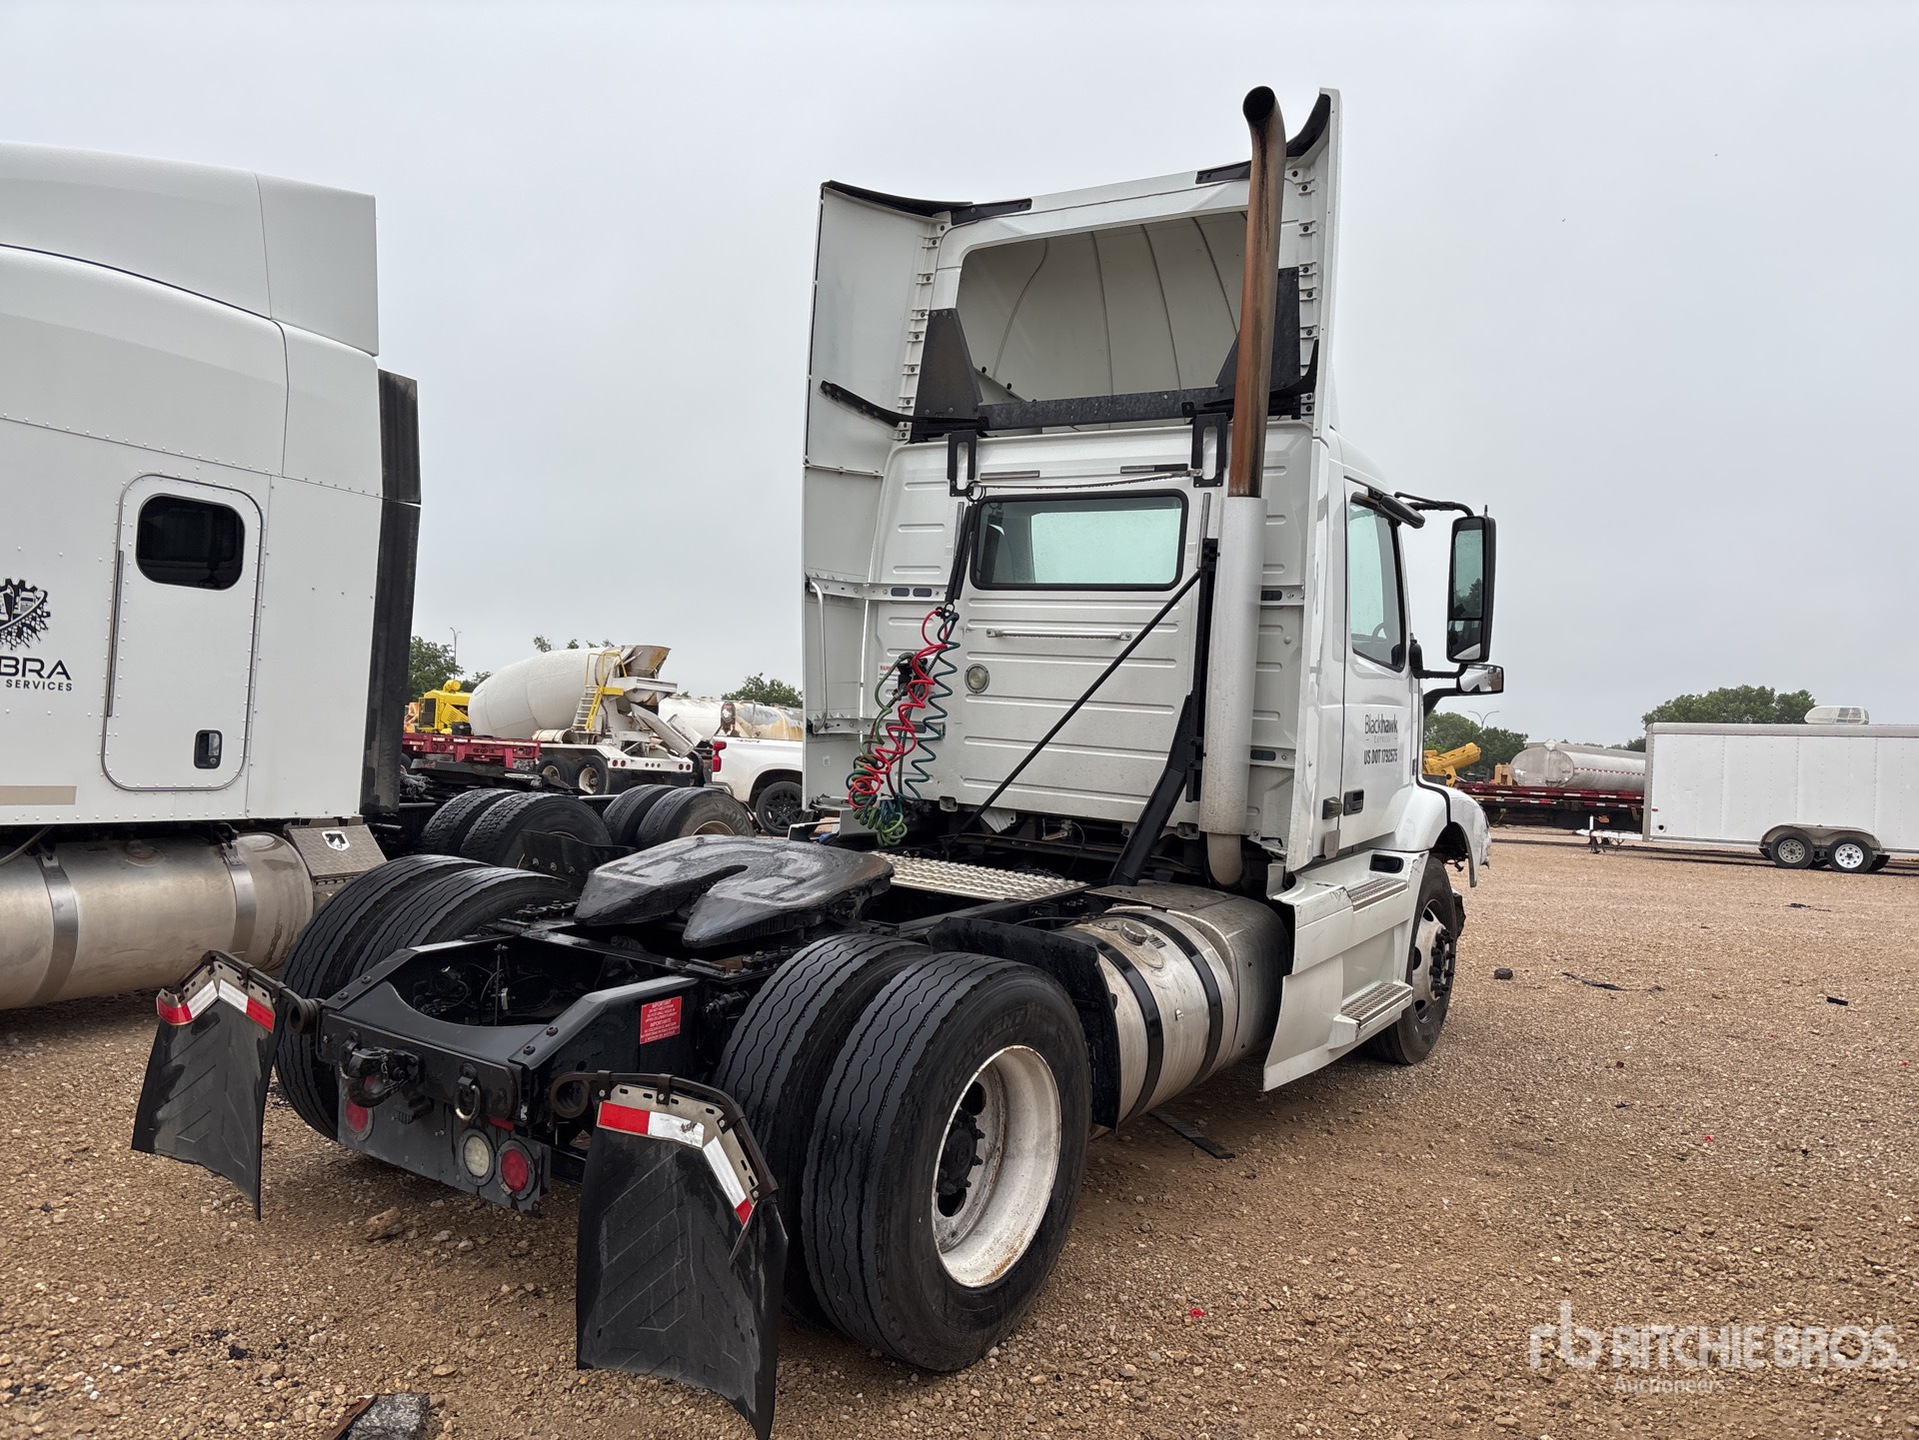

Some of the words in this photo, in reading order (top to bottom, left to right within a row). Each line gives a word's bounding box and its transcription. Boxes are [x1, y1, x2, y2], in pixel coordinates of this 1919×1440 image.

[6, 679, 73, 692] SERVICES
[1364, 713, 1398, 734] Blackhawk
[1363, 749, 1371, 765] US
[1371, 748, 1381, 764] DOT
